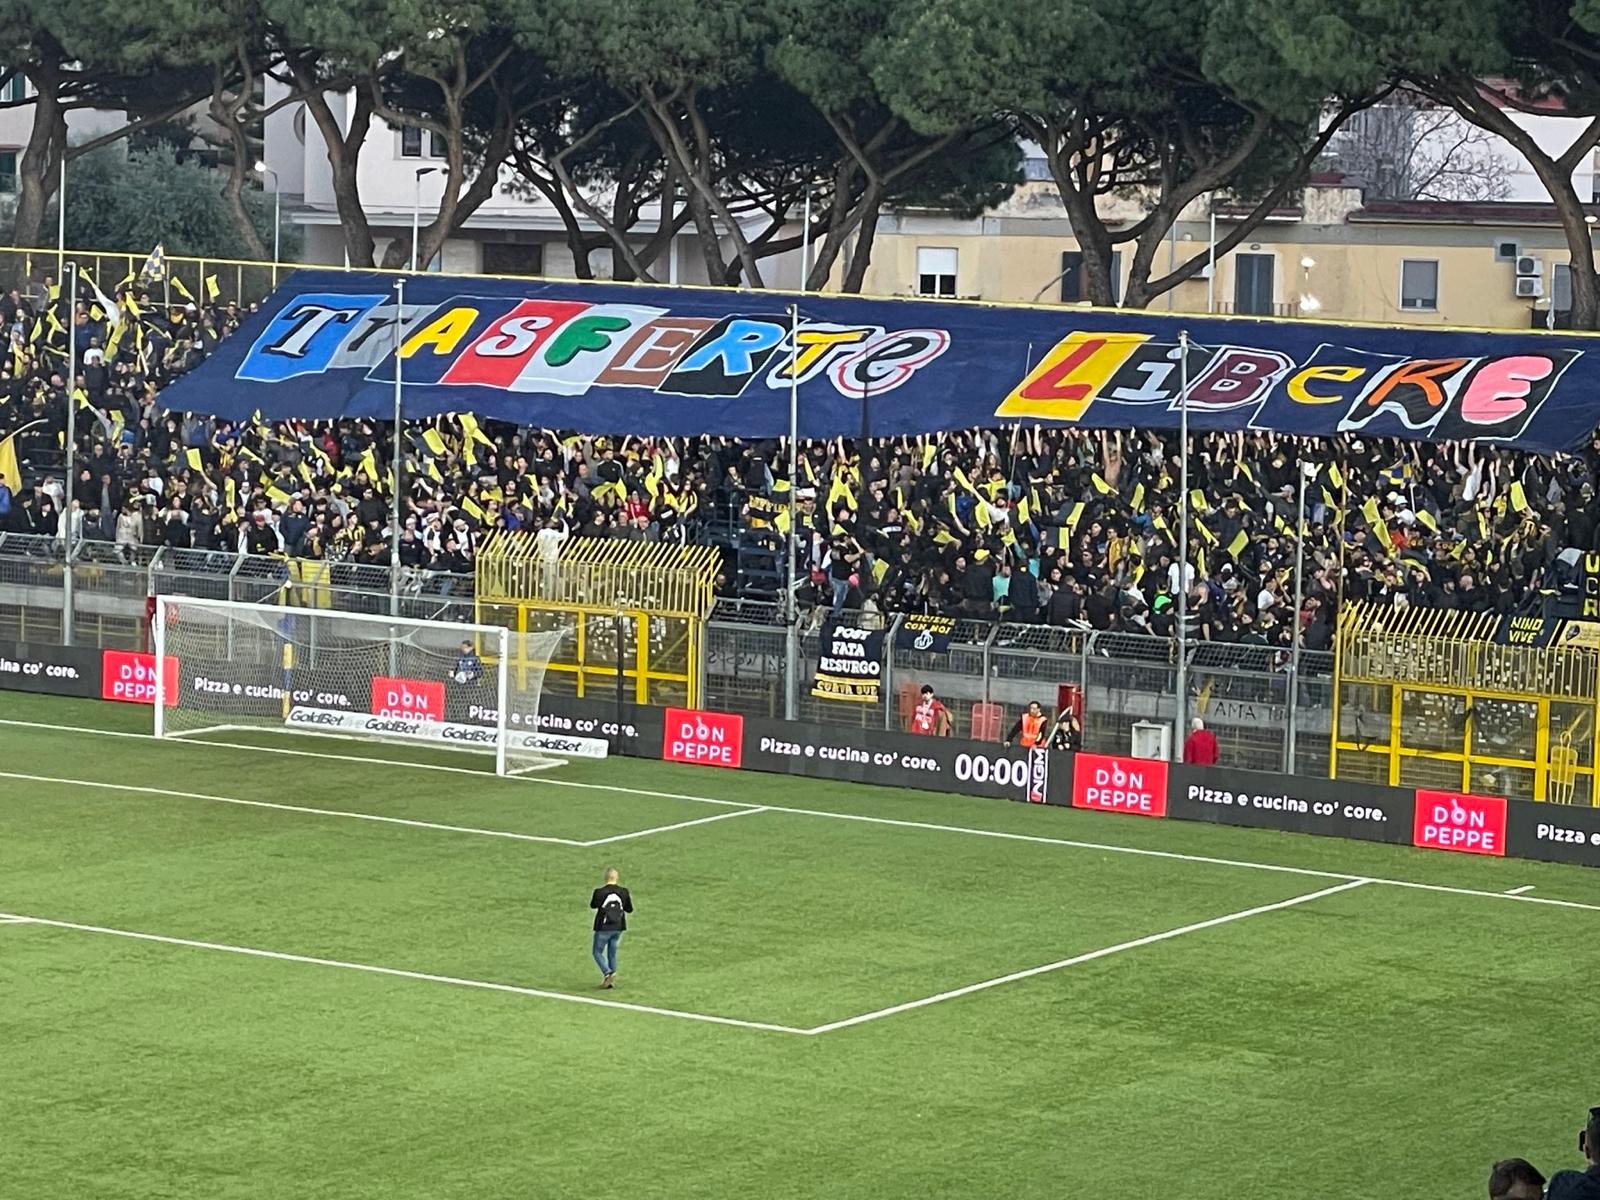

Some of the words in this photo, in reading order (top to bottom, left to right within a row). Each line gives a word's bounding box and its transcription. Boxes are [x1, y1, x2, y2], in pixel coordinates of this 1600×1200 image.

[833, 625, 872, 640] POST
[904, 622, 927, 631] CON
[930, 624, 951, 635] NOI
[1510, 616, 1544, 631] NINO
[1509, 630, 1537, 644] VIVE
[832, 641, 865, 657] FATA
[0, 658, 20, 672] ina
[23, 661, 43, 675] co'
[46, 665, 79, 679] core.
[820, 656, 880, 675] RESURGO
[194, 677, 230, 694] Pizza
[233, 684, 242, 695] e
[293, 689, 313, 702] co'
[316, 692, 351, 706] core.
[387, 690, 428, 710] DON
[511, 713, 520, 724] e
[525, 713, 572, 730] cucina
[576, 719, 598, 732] co'
[602, 724, 639, 737] coe.
[681, 723, 724, 742] DON
[673, 741, 732, 762] PEPPE
[760, 737, 801, 756] Pizza
[804, 745, 815, 757] e
[819, 747, 870, 763] cucina
[874, 751, 898, 766] co'
[901, 755, 941, 772] core.
[955, 753, 1027, 787] 00:00
[1096, 769, 1143, 790] DON
[1086, 787, 1152, 811] PEPPE
[1188, 785, 1233, 805] Pizza
[1237, 793, 1249, 806] e
[1253, 794, 1309, 813] cucina
[1313, 801, 1339, 816] co'
[1343, 805, 1388, 822] core.
[1433, 806, 1485, 828] DON
[1424, 825, 1495, 850] PEPPE
[1537, 824, 1586, 844] Pizza
